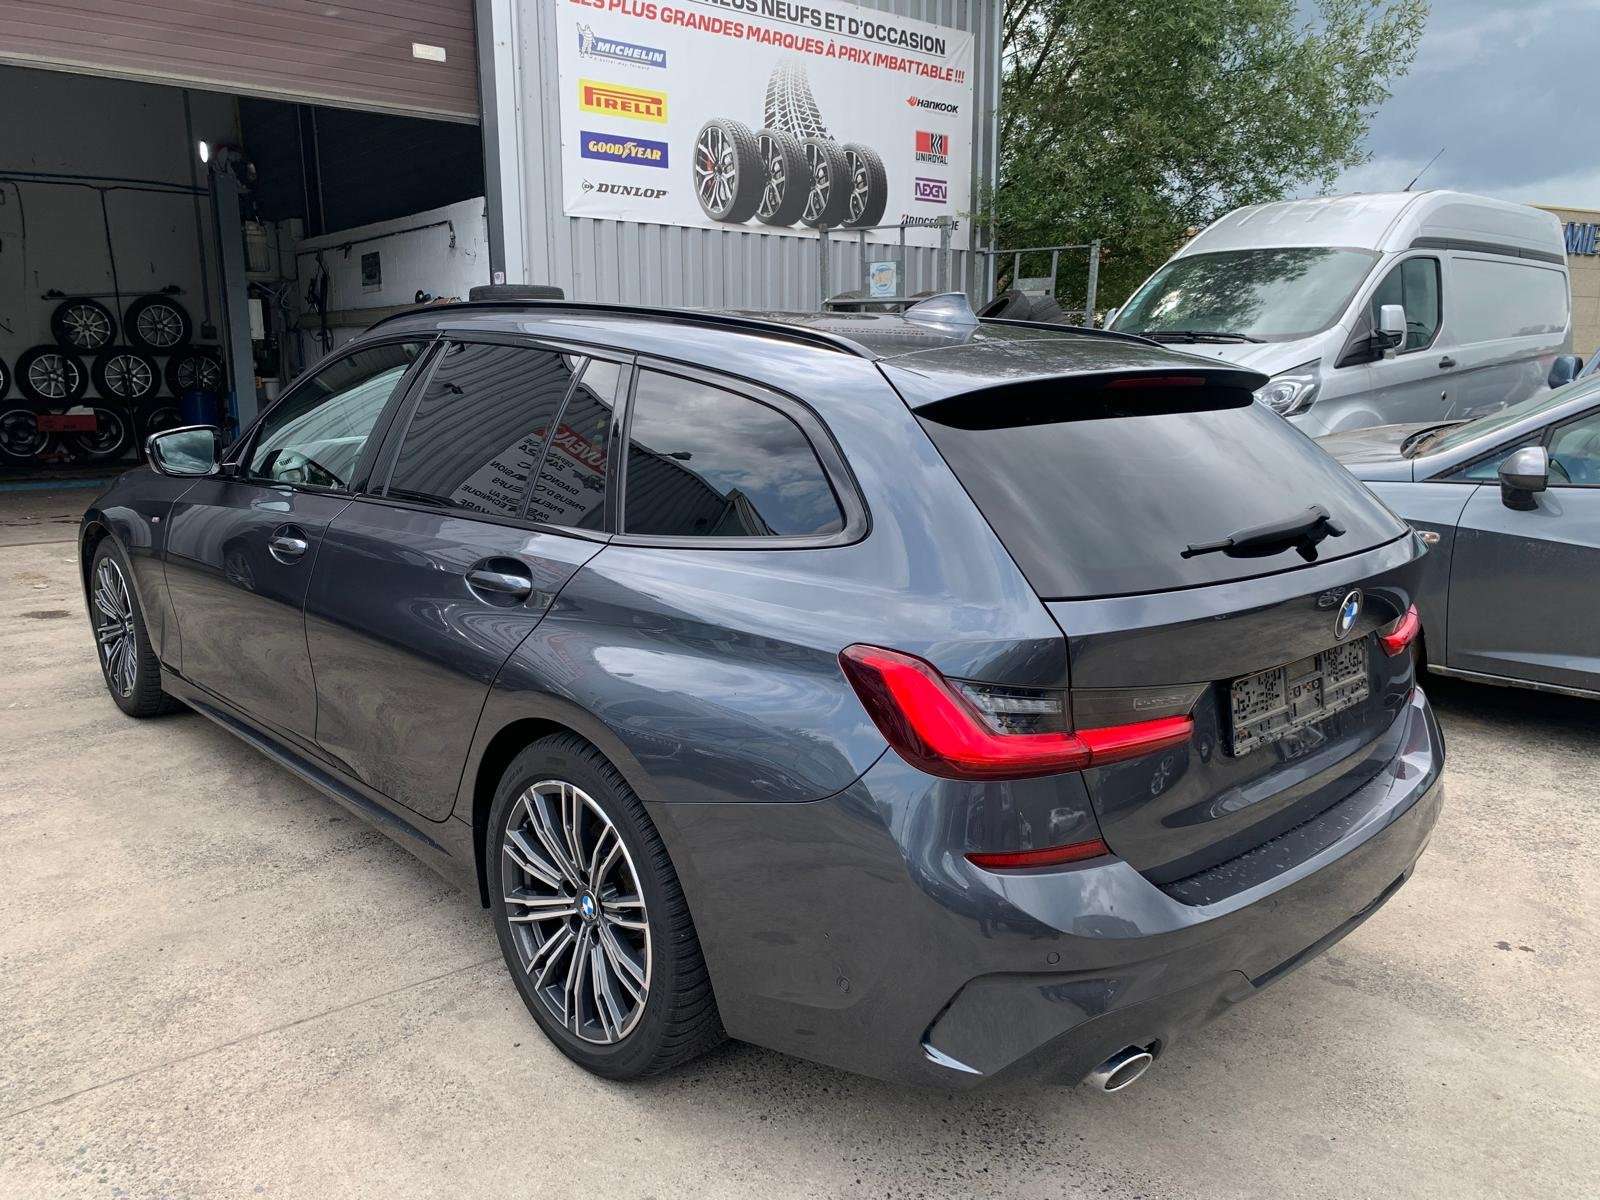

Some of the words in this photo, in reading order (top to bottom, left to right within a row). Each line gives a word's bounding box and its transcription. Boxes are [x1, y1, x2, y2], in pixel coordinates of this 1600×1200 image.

[761, 0, 822, 27] NEUFS
[825, 12, 846, 32] ET
[849, 18, 947, 55] D'OCCASION
[596, 41, 664, 62] MICHELIN
[608, 0, 658, 20] PLUS
[660, 7, 744, 39] GRANDES
[746, 24, 824, 55] MARQUES
[825, 39, 837, 58] À
[838, 46, 872, 66] PRIX
[872, 53, 954, 82] IMBATTABLE
[584, 85, 663, 117] PIRELLI
[588, 140, 662, 161] GOODYEAR
[915, 151, 949, 165] UNIROYAL
[596, 182, 668, 199] DUNLOP
[914, 182, 948, 200] NEXEN
